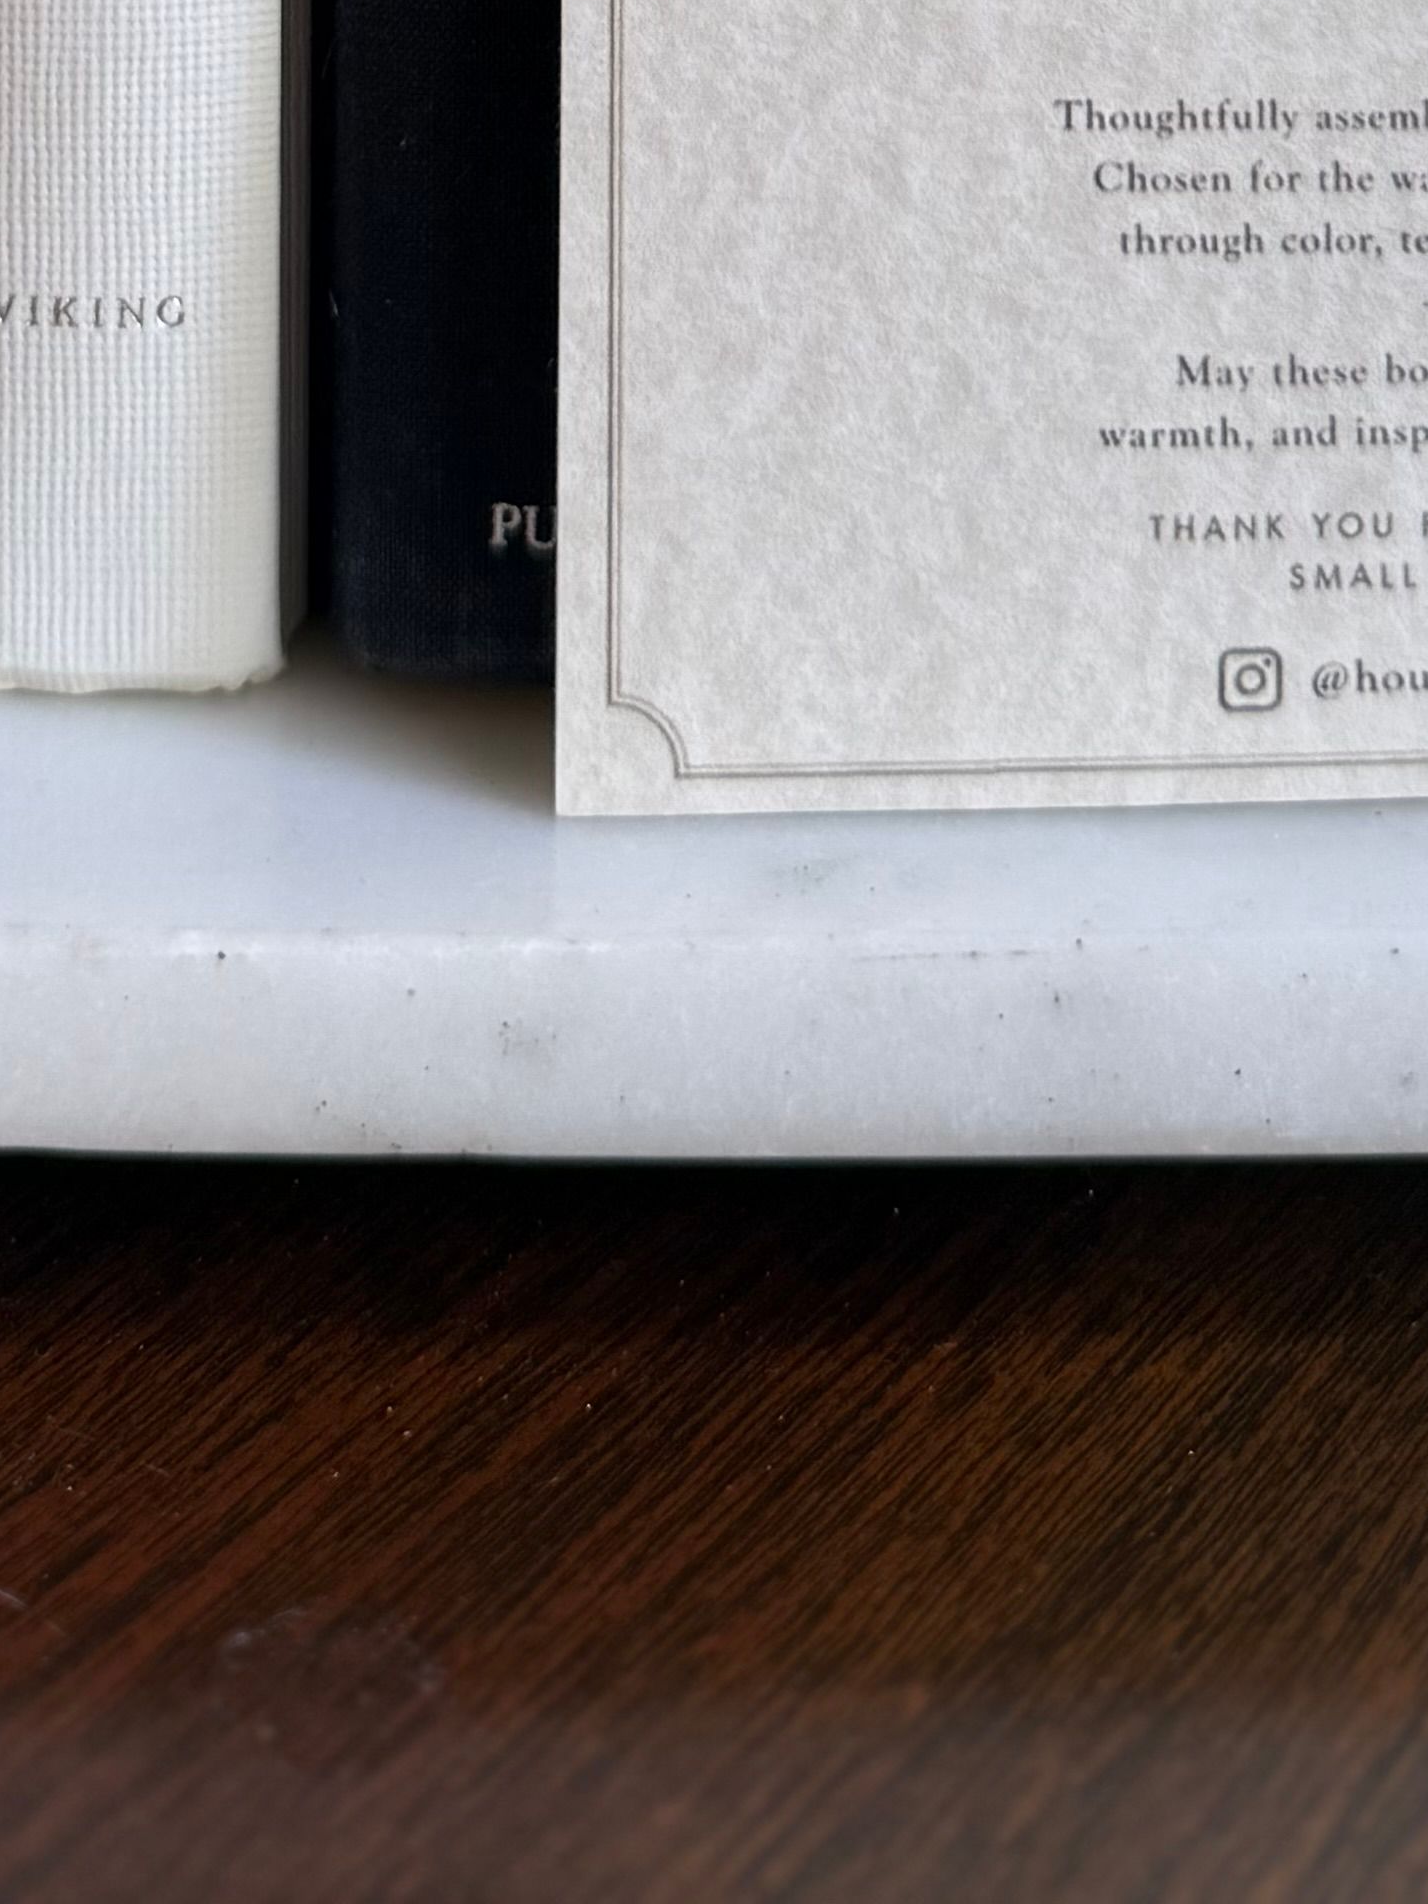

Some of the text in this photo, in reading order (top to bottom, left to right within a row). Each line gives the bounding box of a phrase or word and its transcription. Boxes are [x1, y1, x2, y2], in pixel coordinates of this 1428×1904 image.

[1052, 97, 1299, 140] Thoughtfully
[1092, 160, 1233, 195] Chosen
[1249, 158, 1303, 195] for
[1317, 159, 1375, 195] the
[1119, 221, 1265, 263] through
[1279, 221, 1384, 260] color,
[1176, 354, 1254, 393] May
[1272, 352, 1368, 389] these
[1098, 415, 1255, 453] warmth,
[1271, 413, 1338, 450] and
[1148, 513, 1285, 545] THANK
[1311, 511, 1395, 543] YOU
[1289, 561, 1418, 594] SMALL
